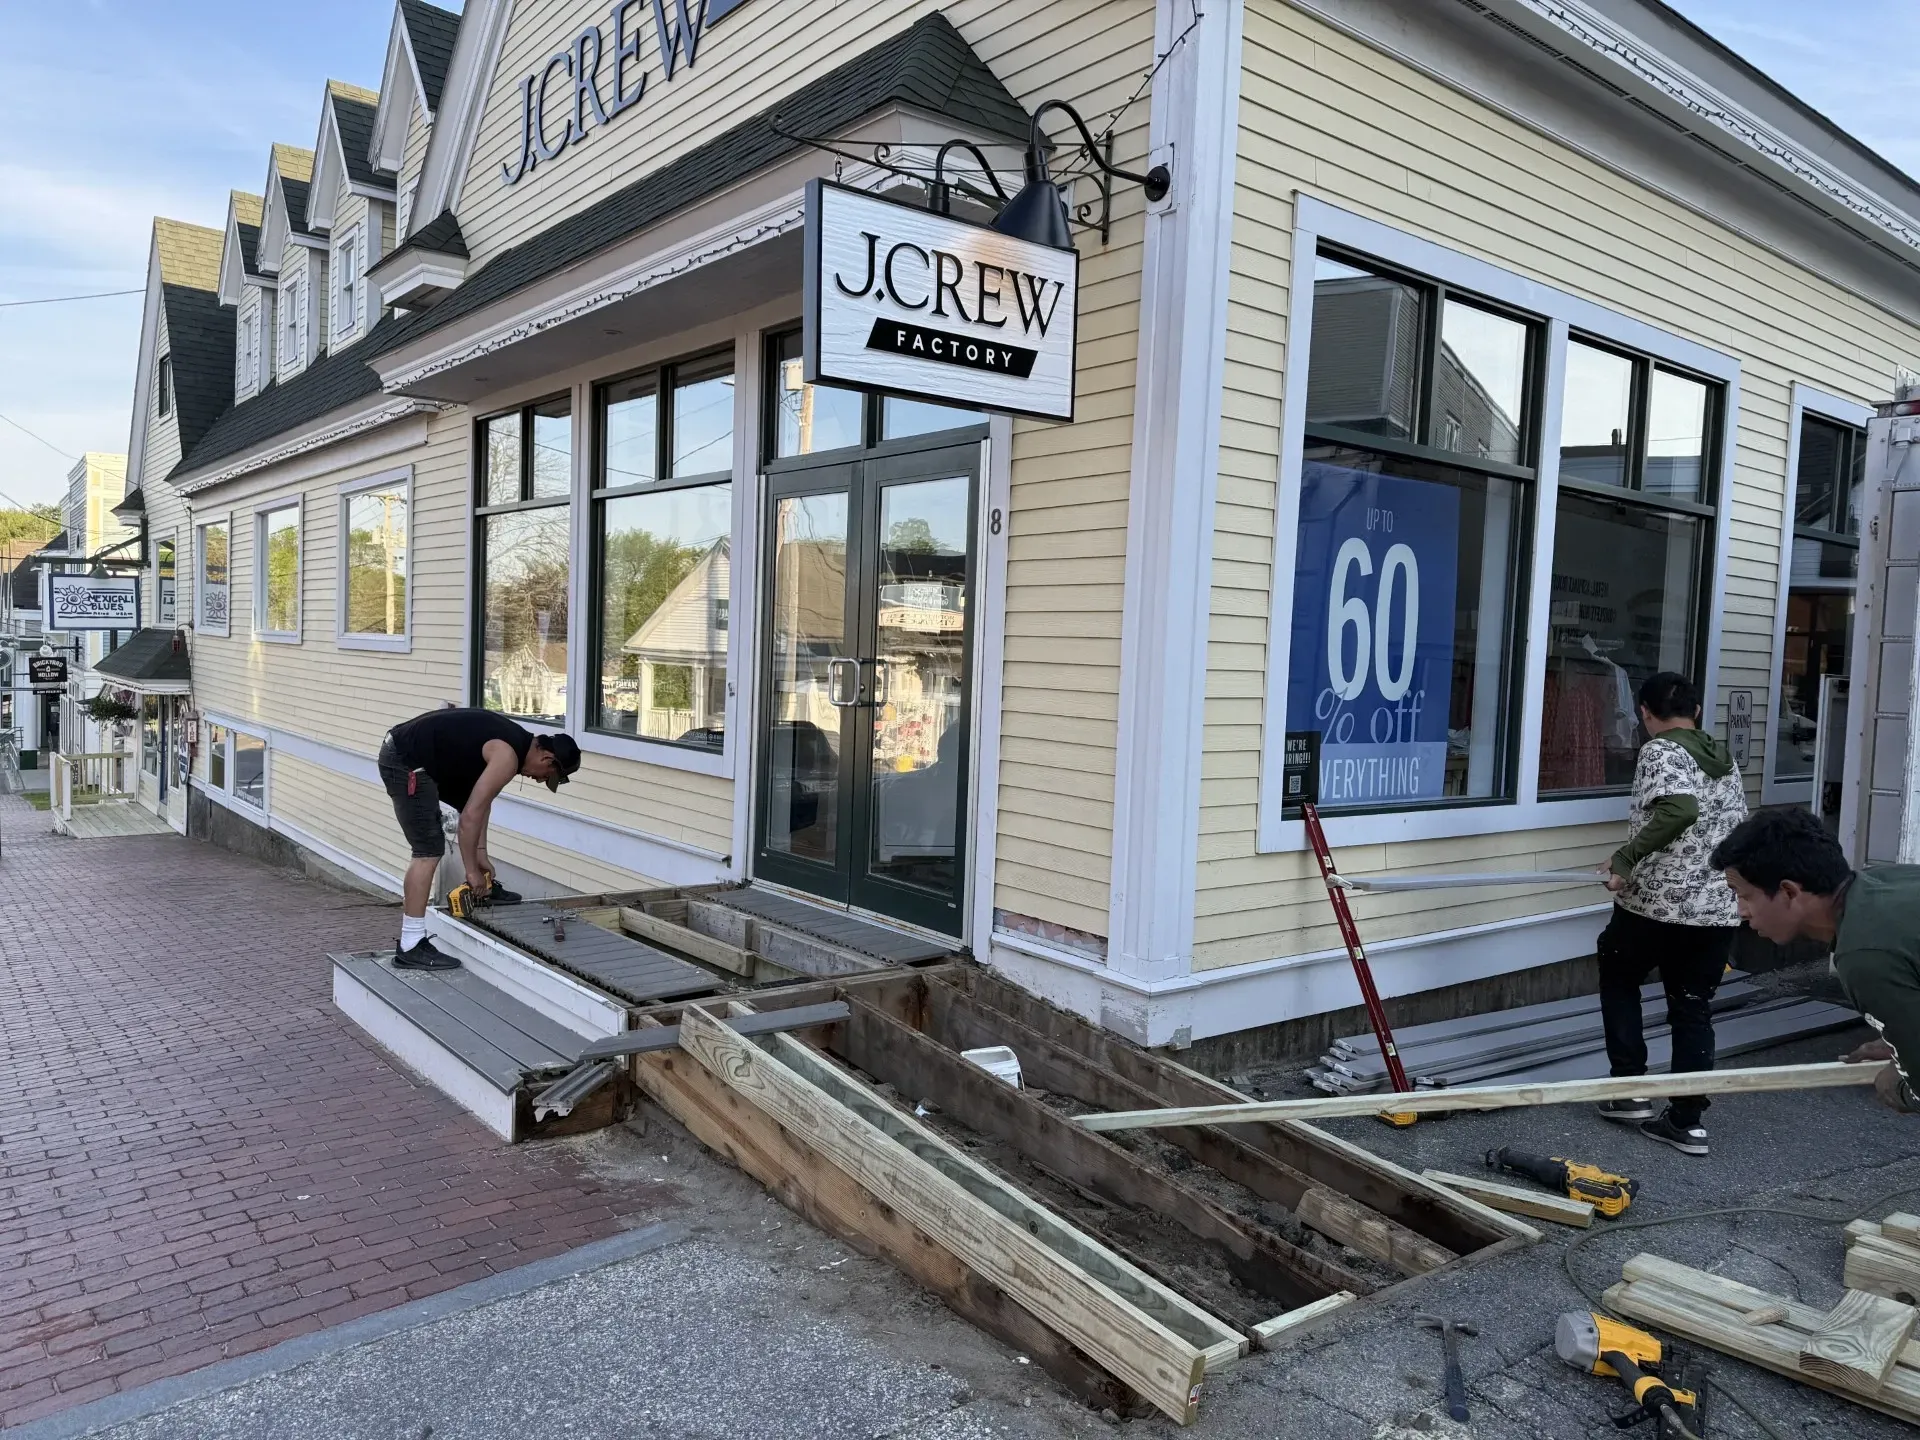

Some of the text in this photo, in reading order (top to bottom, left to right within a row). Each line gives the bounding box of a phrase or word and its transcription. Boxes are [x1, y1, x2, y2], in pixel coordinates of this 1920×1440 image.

[501, 0, 705, 184] J.CREW
[834, 231, 1064, 338] J.CREW
[897, 330, 1012, 368] FACTORY
[990, 508, 1001, 535] 8
[1366, 507, 1394, 533] UP TO
[88, 595, 134, 603] MEXICALI
[1327, 537, 1419, 702] 60
[1370, 689, 1425, 744] off
[1737, 695, 1746, 711] NO
[1731, 714, 1751, 728] PARKING
[1285, 752, 1311, 764] IRING!!!
[1287, 739, 1307, 751] WE'RE
[1319, 757, 1419, 799] VERYTHING
